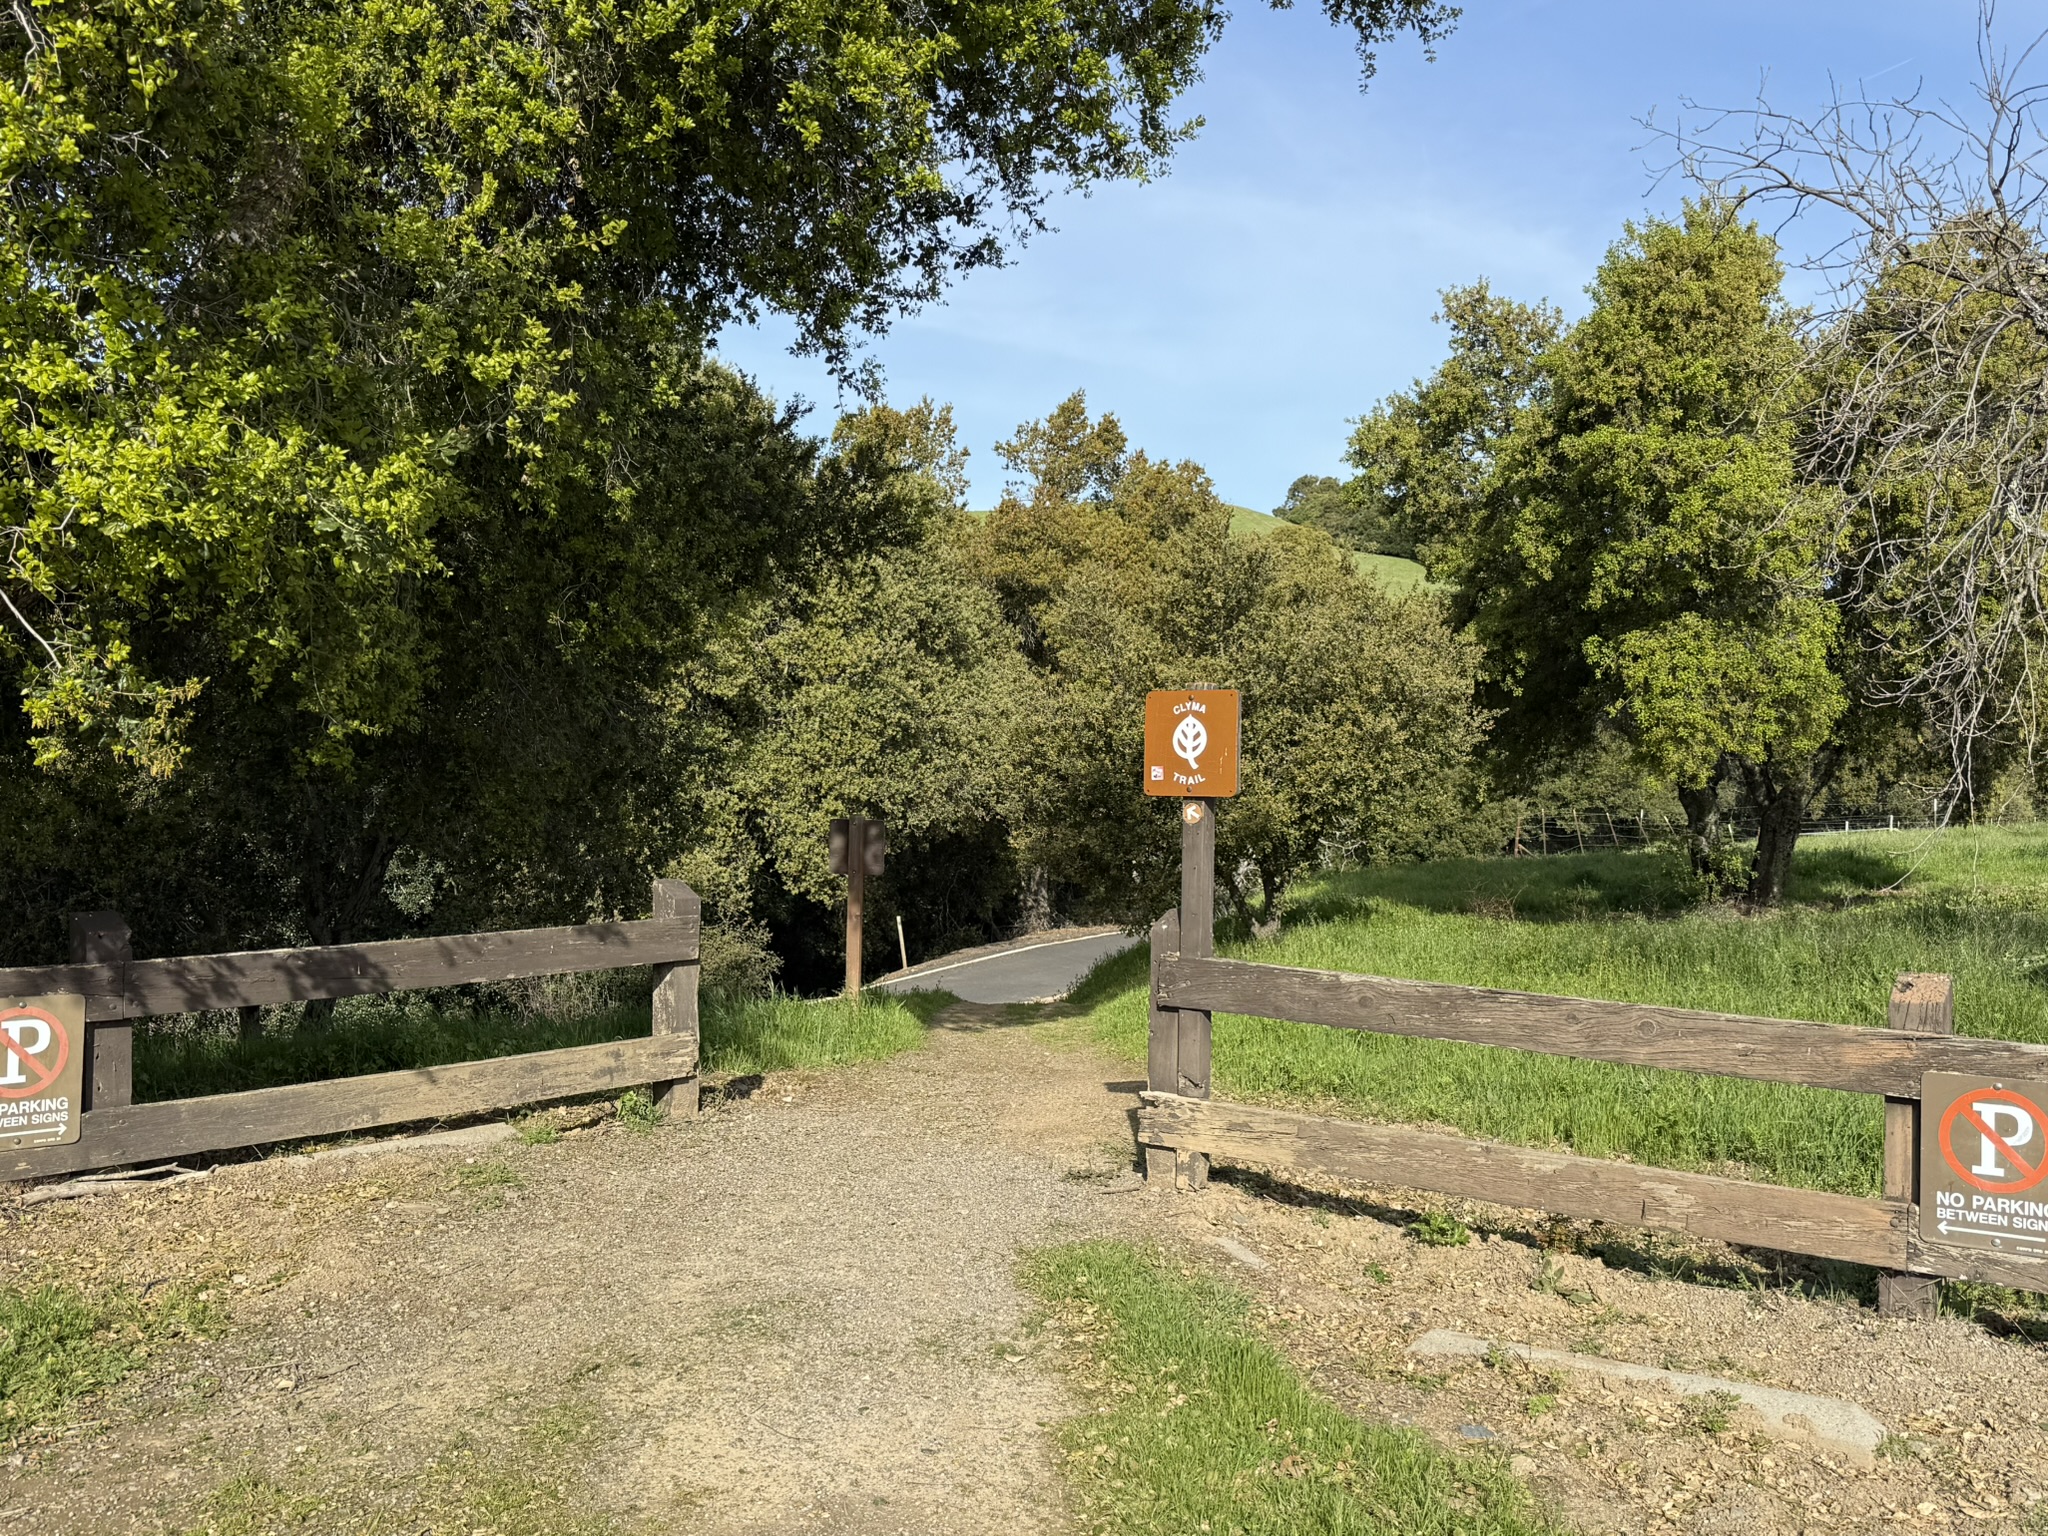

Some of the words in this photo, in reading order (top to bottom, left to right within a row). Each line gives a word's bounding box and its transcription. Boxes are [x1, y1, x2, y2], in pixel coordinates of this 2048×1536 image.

[1172, 701, 1207, 715] CLYMA
[1172, 772, 1206, 785] TRAIL
[0, 1096, 69, 1116] PARKING
[0, 1115, 28, 1128] EEN
[31, 1111, 69, 1125] SIGNS
[1936, 1190, 1965, 1208] NO
[1936, 1207, 2008, 1227] BETWEEN
